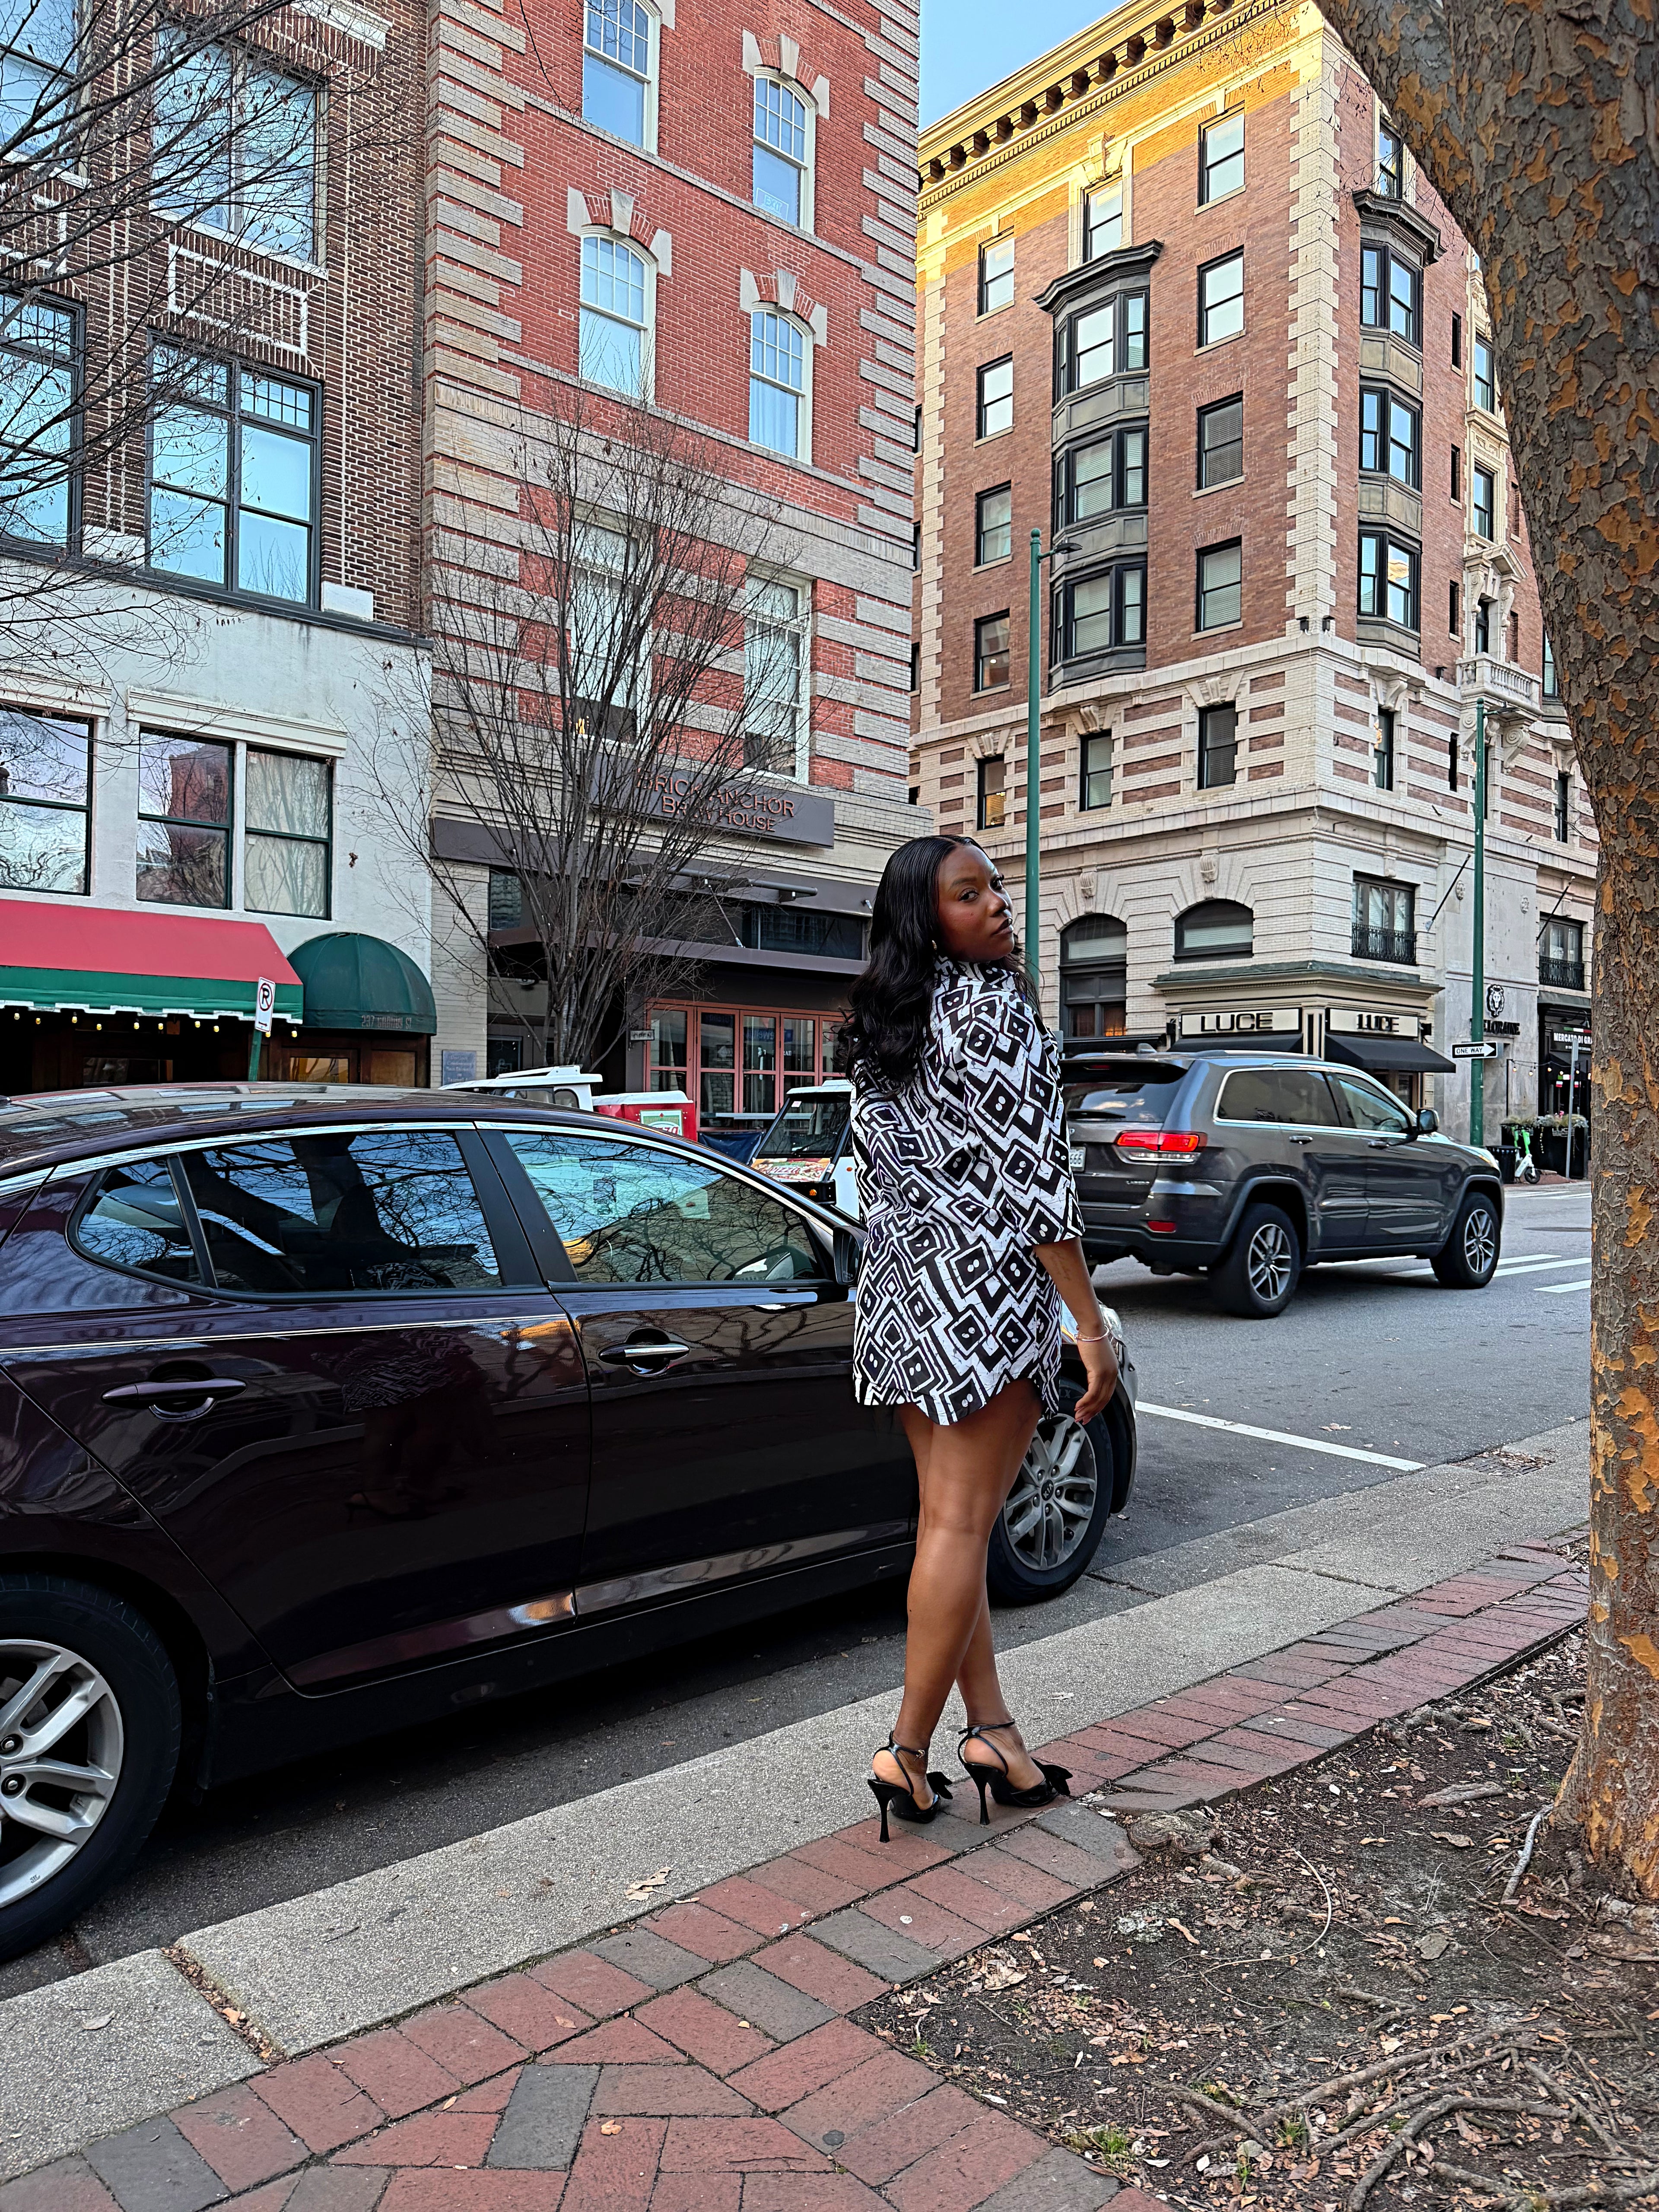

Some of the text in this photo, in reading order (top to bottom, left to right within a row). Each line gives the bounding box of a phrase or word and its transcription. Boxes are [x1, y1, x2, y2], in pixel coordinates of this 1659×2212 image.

[662, 796, 714, 820] BRW
[708, 788, 795, 817] ANCHOR
[362, 1015, 375, 1027] 237
[1201, 1012, 1273, 1032] LUCE
[1358, 1014, 1399, 1032] LUCE
[1043, 1483, 1053, 1498] KIA
